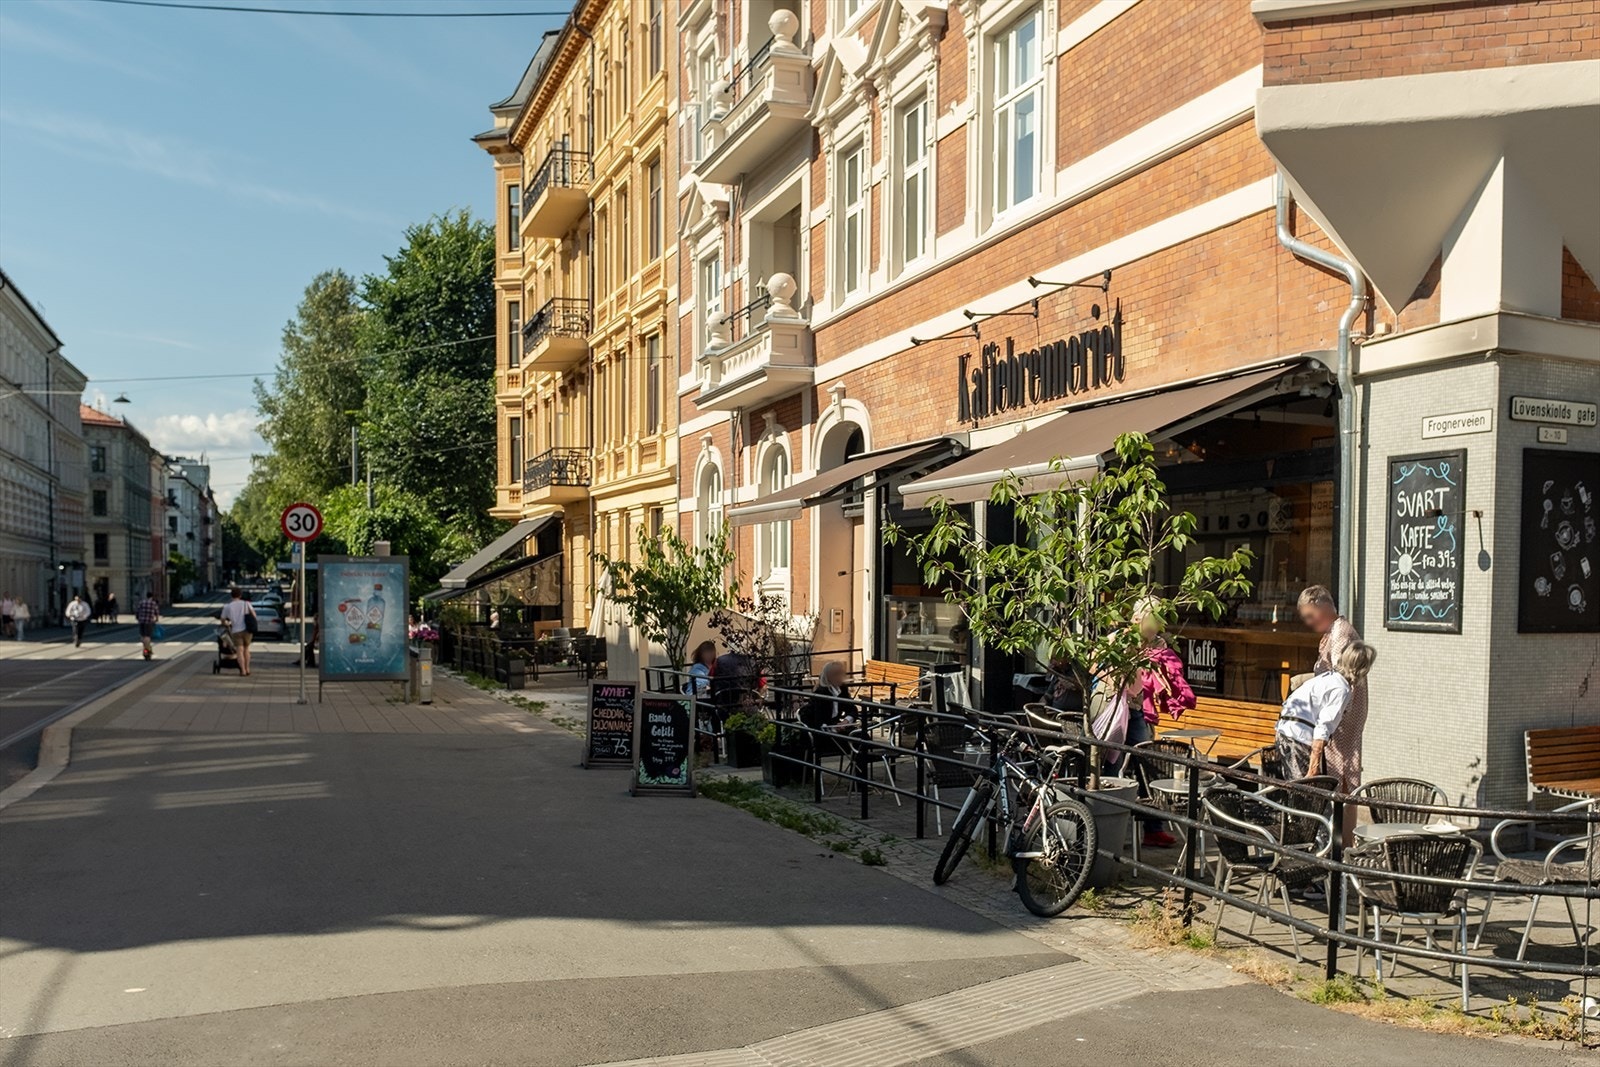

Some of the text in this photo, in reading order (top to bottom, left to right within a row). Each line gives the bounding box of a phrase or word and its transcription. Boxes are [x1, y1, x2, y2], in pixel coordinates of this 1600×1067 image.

[957, 297, 1126, 424] Kaffebrenneriet
[1428, 415, 1485, 432] Frognerveien
[1577, 408, 1596, 423] gate
[1397, 487, 1450, 518] SVART
[289, 513, 315, 532] 30
[1401, 523, 1435, 549] KAFFE
[1422, 554, 1436, 569] fra
[1417, 578, 1425, 589] du
[1188, 639, 1217, 667] Kaffe
[593, 708, 624, 719] CHEDDAR
